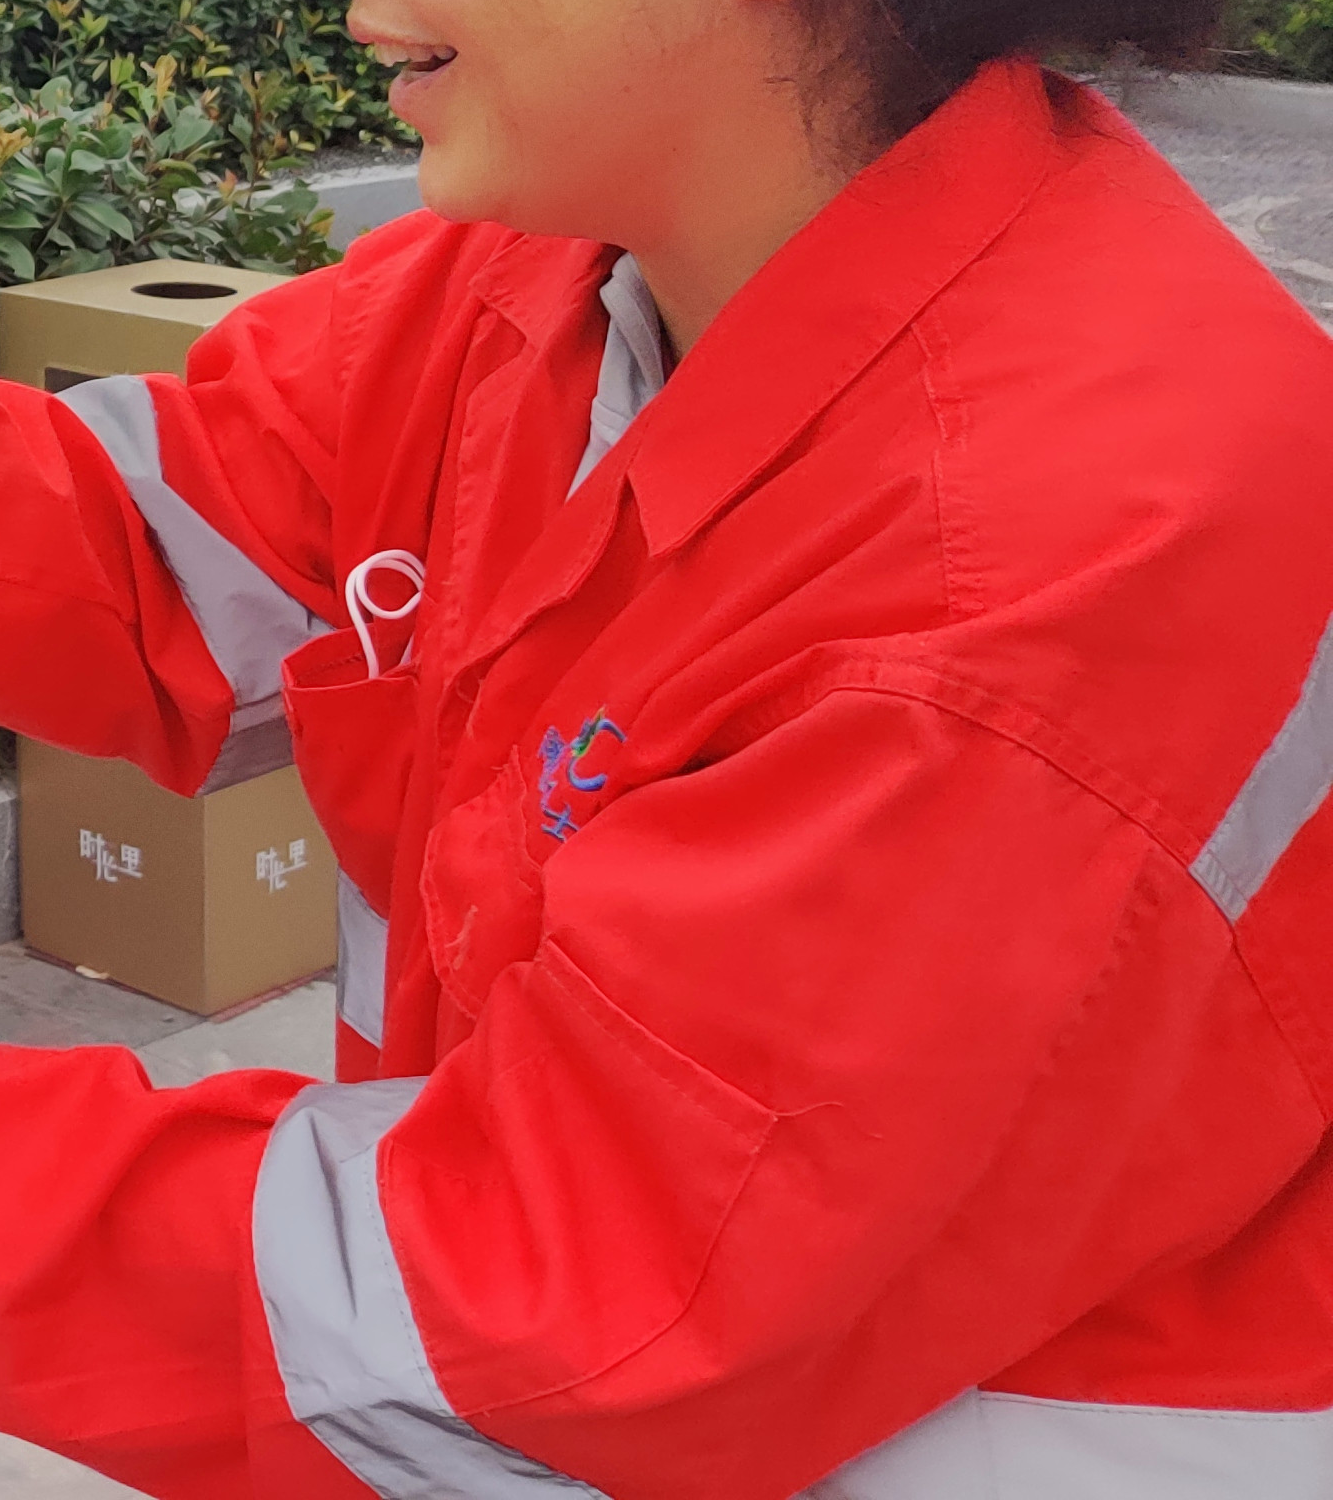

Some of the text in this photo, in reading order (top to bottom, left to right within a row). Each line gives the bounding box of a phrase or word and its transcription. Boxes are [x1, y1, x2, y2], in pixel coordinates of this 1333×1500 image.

[79, 829, 144, 883] 时光里
[256, 838, 309, 895] 时光里
